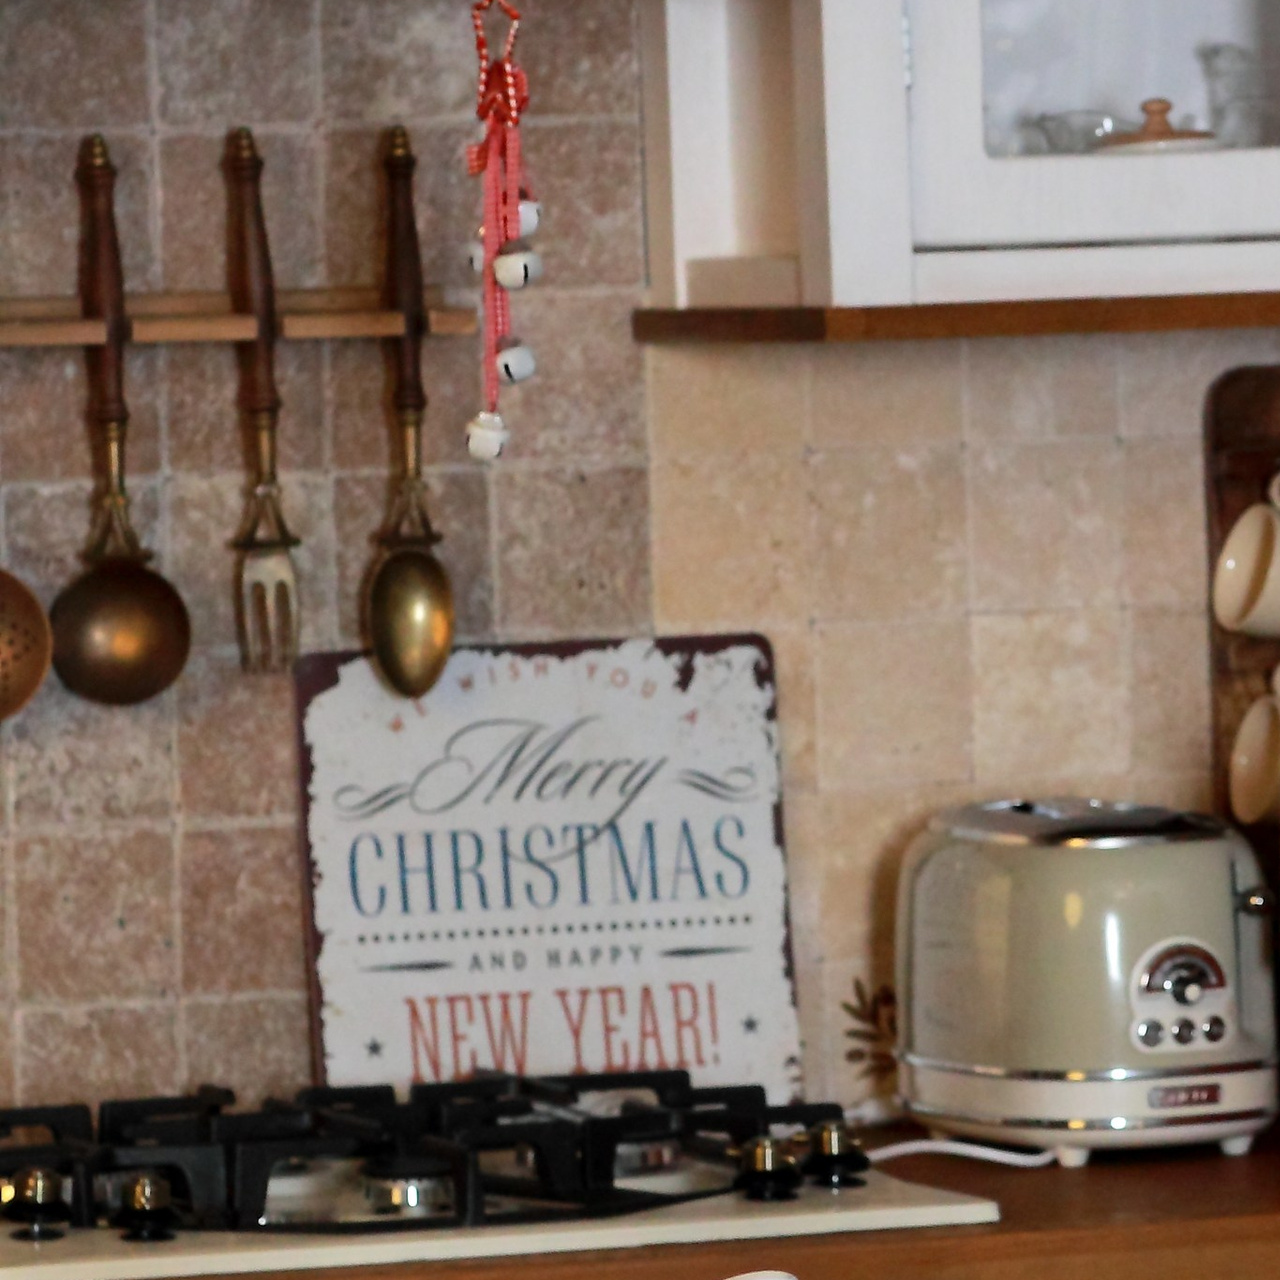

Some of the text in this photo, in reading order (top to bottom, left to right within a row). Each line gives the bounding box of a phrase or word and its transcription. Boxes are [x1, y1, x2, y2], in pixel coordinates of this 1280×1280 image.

[459, 659, 548, 692] WISH
[586, 662, 657, 700] YOU
[408, 715, 669, 864] Merry
[348, 814, 751, 918] CHRISTMAS
[468, 944, 644, 972] AND HAPPY
[403, 979, 721, 1082] NEW YEAR!
